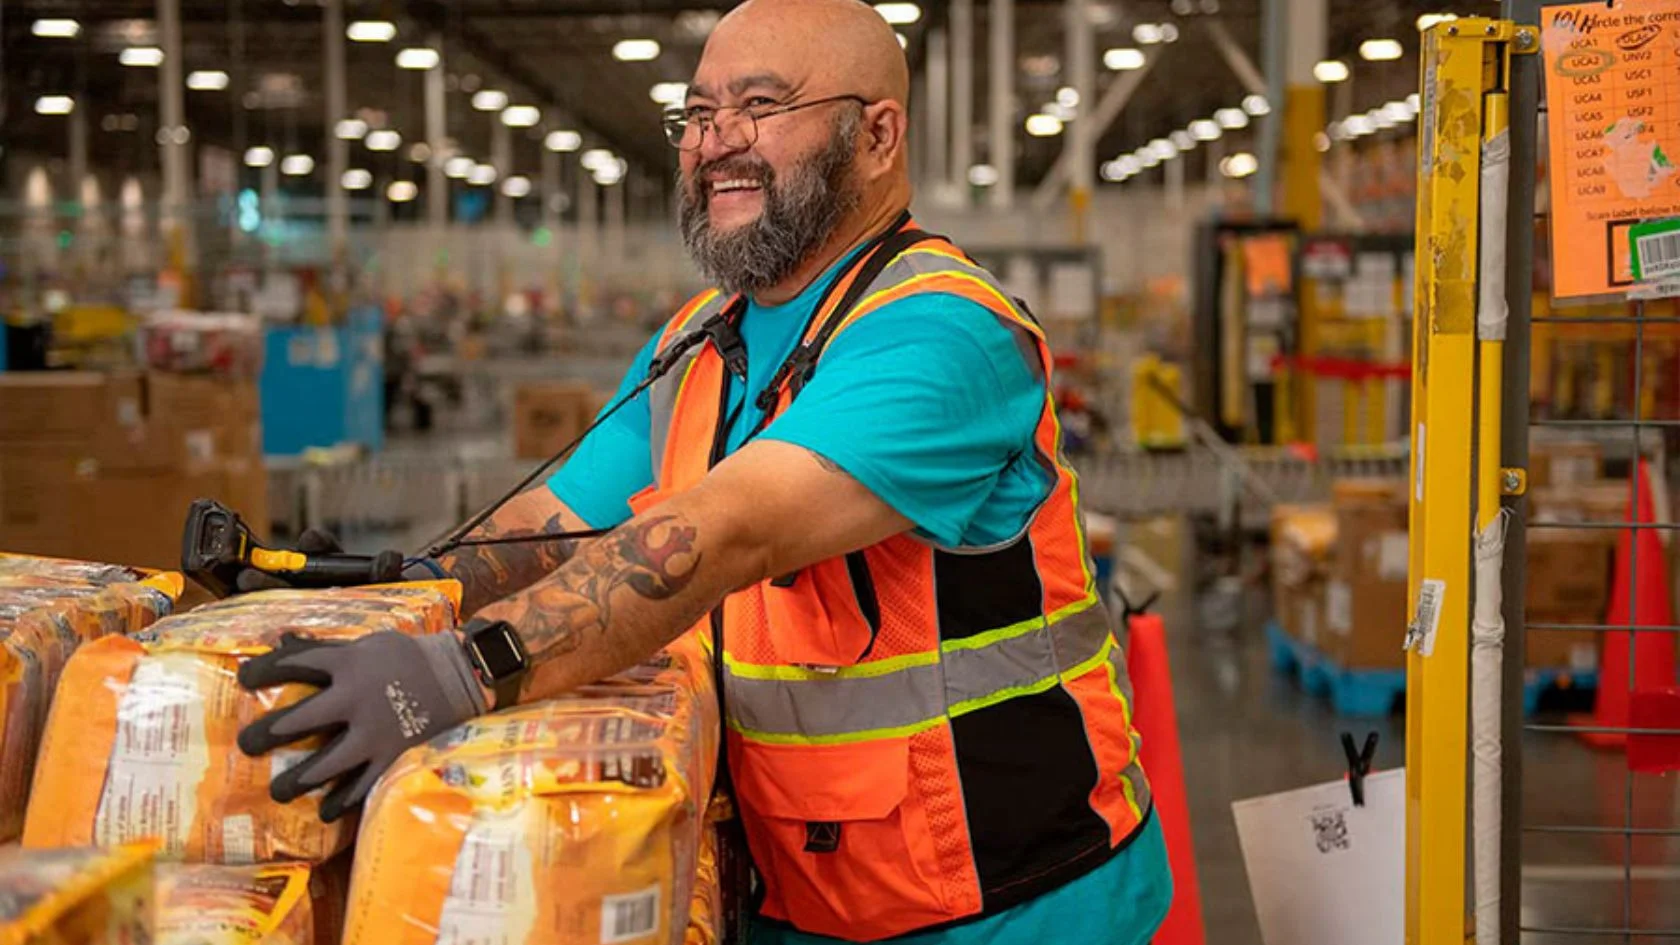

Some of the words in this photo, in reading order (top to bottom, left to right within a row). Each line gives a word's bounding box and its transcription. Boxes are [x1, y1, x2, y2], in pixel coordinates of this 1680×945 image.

[1589, 16, 1620, 30] ircle
[1623, 14, 1645, 26] the
[1571, 38, 1598, 50] UCA1
[1571, 55, 1599, 68] UCA2
[1624, 69, 1652, 81] USC1
[1574, 92, 1602, 105] UCA4
[1626, 87, 1653, 99] USF1
[1627, 106, 1654, 117] USF2
[1576, 147, 1605, 159] UCA7
[1613, 206, 1638, 218] label
[1641, 204, 1669, 214] below
